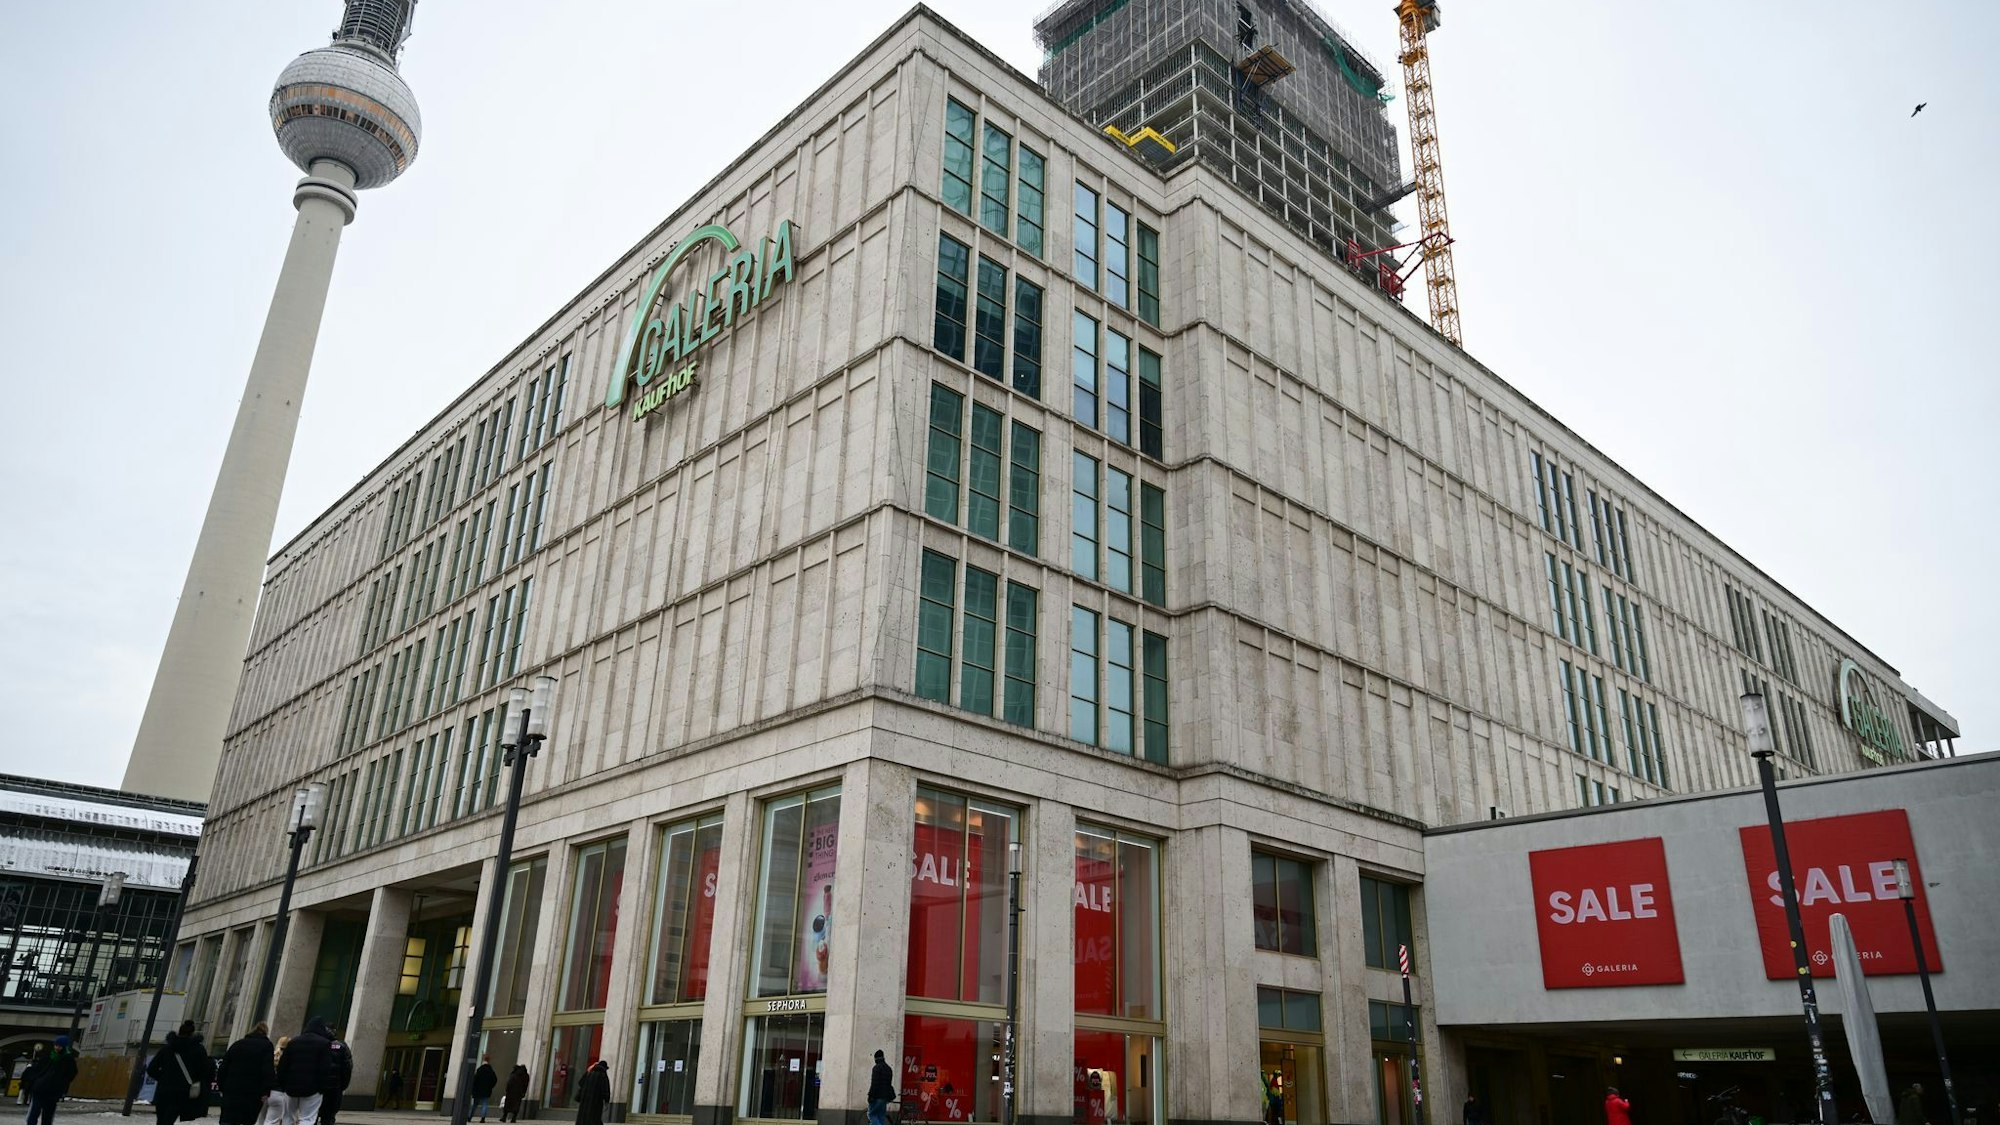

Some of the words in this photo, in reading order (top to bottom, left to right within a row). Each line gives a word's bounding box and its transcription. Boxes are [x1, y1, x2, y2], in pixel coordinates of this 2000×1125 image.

[637, 219, 794, 387] GALERIA
[816, 834, 835, 850] BIG
[1074, 881, 1111, 913] ALE
[1549, 883, 1658, 924] SALE
[1597, 964, 1639, 974] GALERIA
[767, 999, 806, 1012] SEPHORA
[945, 1098, 962, 1119] %
